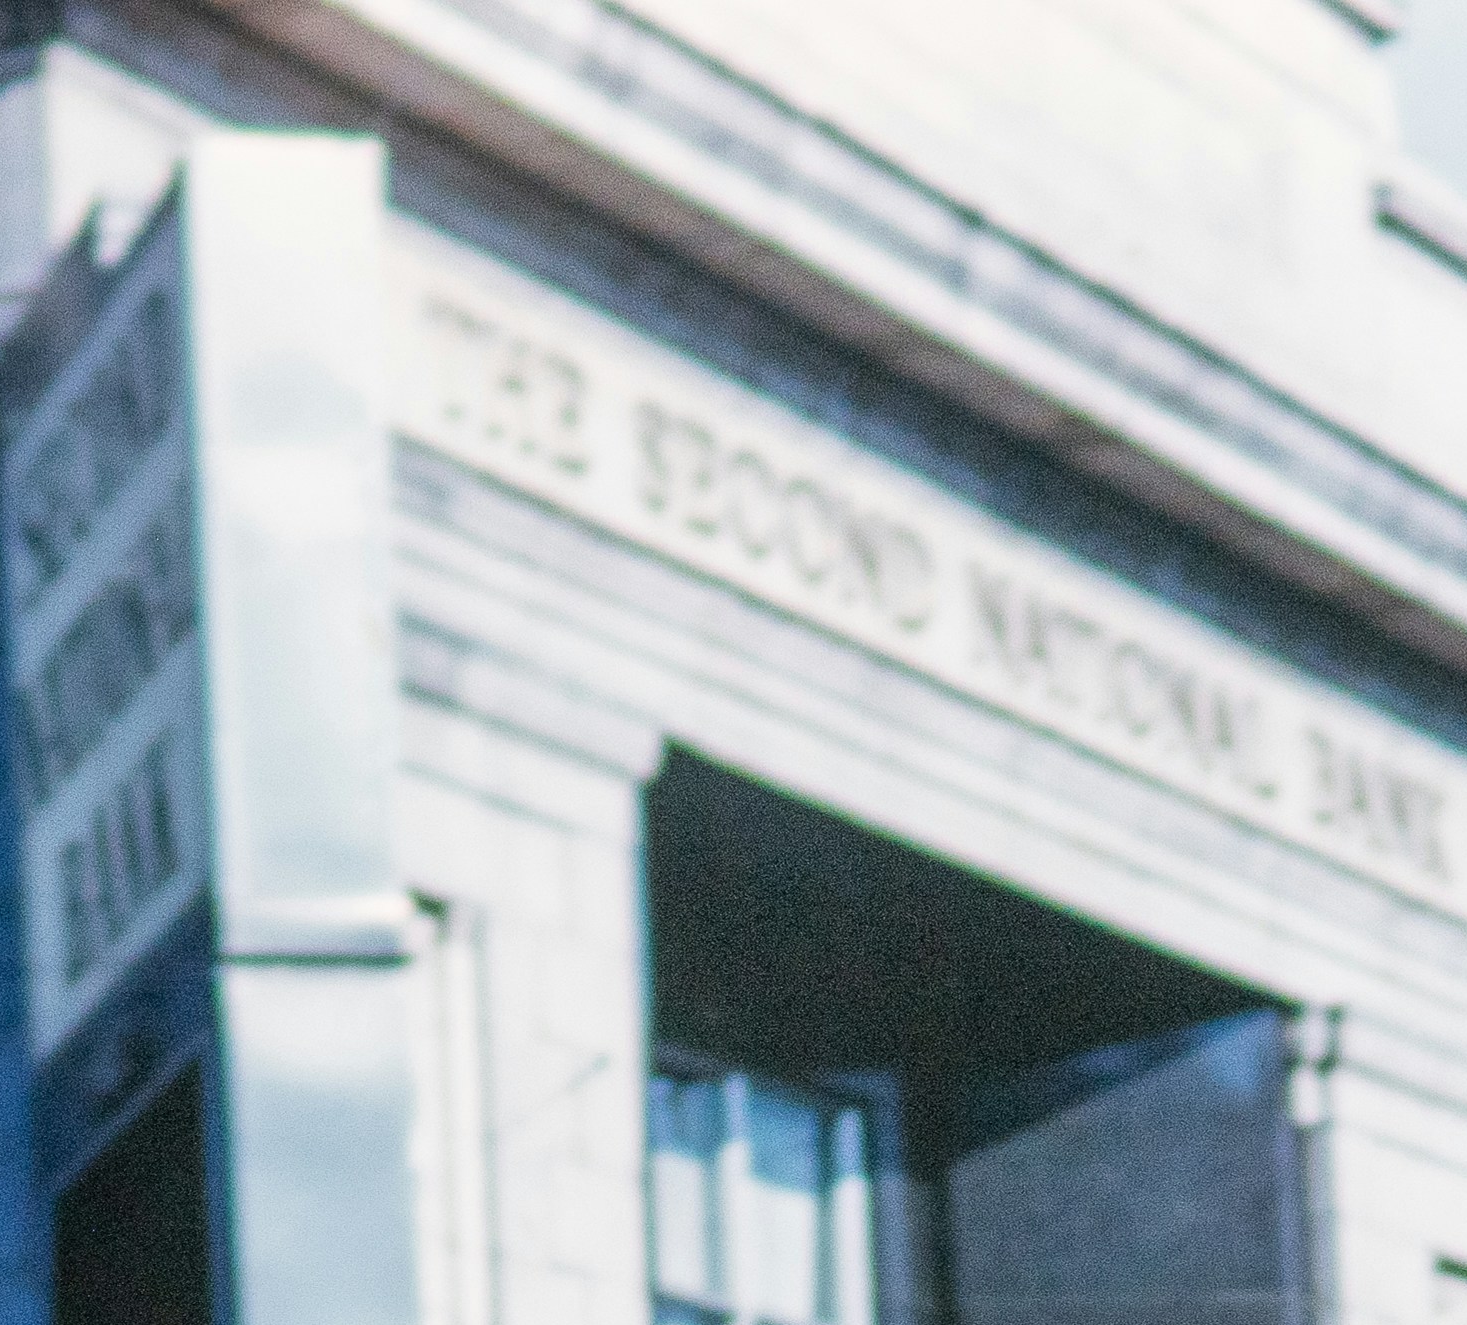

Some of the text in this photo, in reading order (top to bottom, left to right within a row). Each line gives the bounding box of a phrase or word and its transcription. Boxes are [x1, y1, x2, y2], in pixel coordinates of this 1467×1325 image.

[418, 290, 1452, 888] THE SECOND NATIONAL BANK
